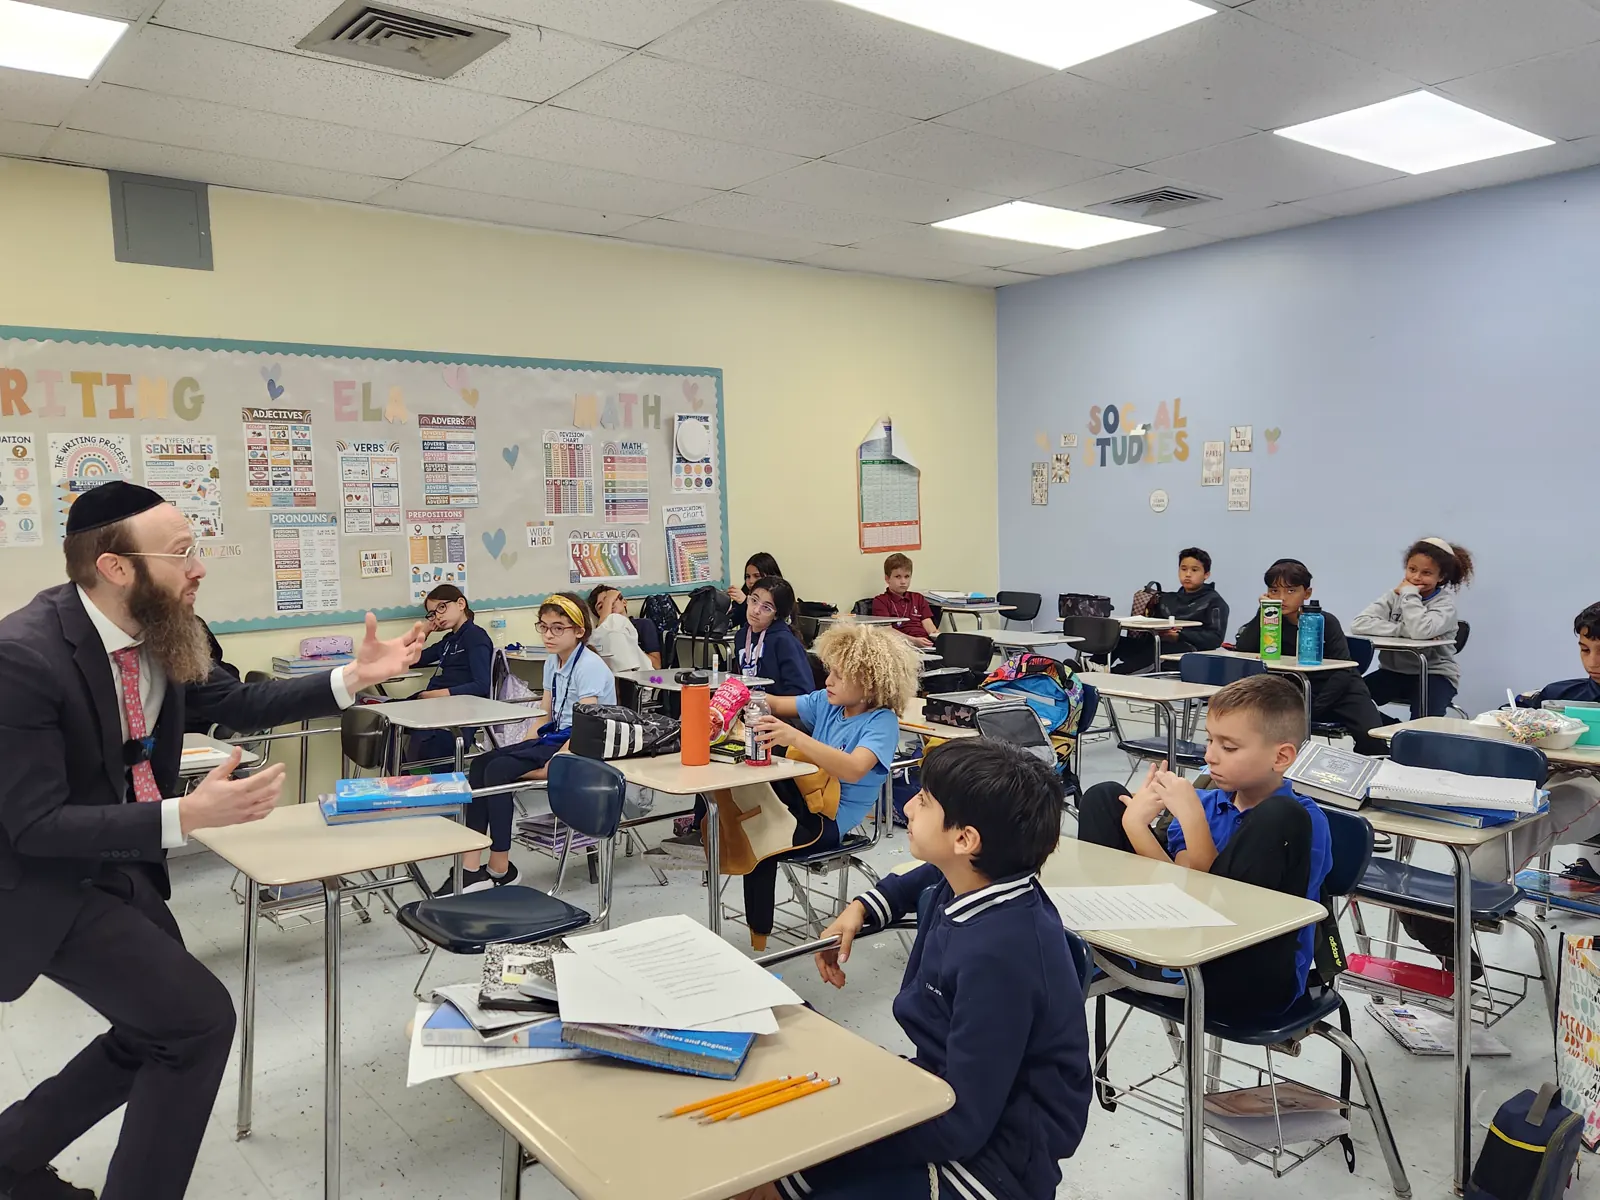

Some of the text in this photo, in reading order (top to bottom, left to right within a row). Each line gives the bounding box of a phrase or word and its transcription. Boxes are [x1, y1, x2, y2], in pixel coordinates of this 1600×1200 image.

[333, 381, 408, 425] ELA
[253, 411, 304, 420] ADJECTIVES
[573, 393, 661, 430] MATH
[431, 416, 465, 425] ADVERBS
[145, 444, 214, 454] SENTENCES
[353, 443, 385, 452] VERBS
[621, 442, 642, 450] MATH
[1083, 430, 1189, 467] STUDIES
[55, 437, 128, 469] THE WRITING PROCESS
[272, 514, 327, 523] PRONOUNS
[408, 511, 463, 519] PREPOSITIONS
[682, 510, 704, 519] chart
[529, 528, 552, 537] WORK
[531, 536, 552, 546] HARD
[1328, 936, 1339, 959] adidas
[1560, 1011, 1592, 1043] MIND
[659, 1031, 733, 1052] States and Regions
[1564, 1031, 1584, 1053] BODY
[1580, 1087, 1598, 1102] SOUL
